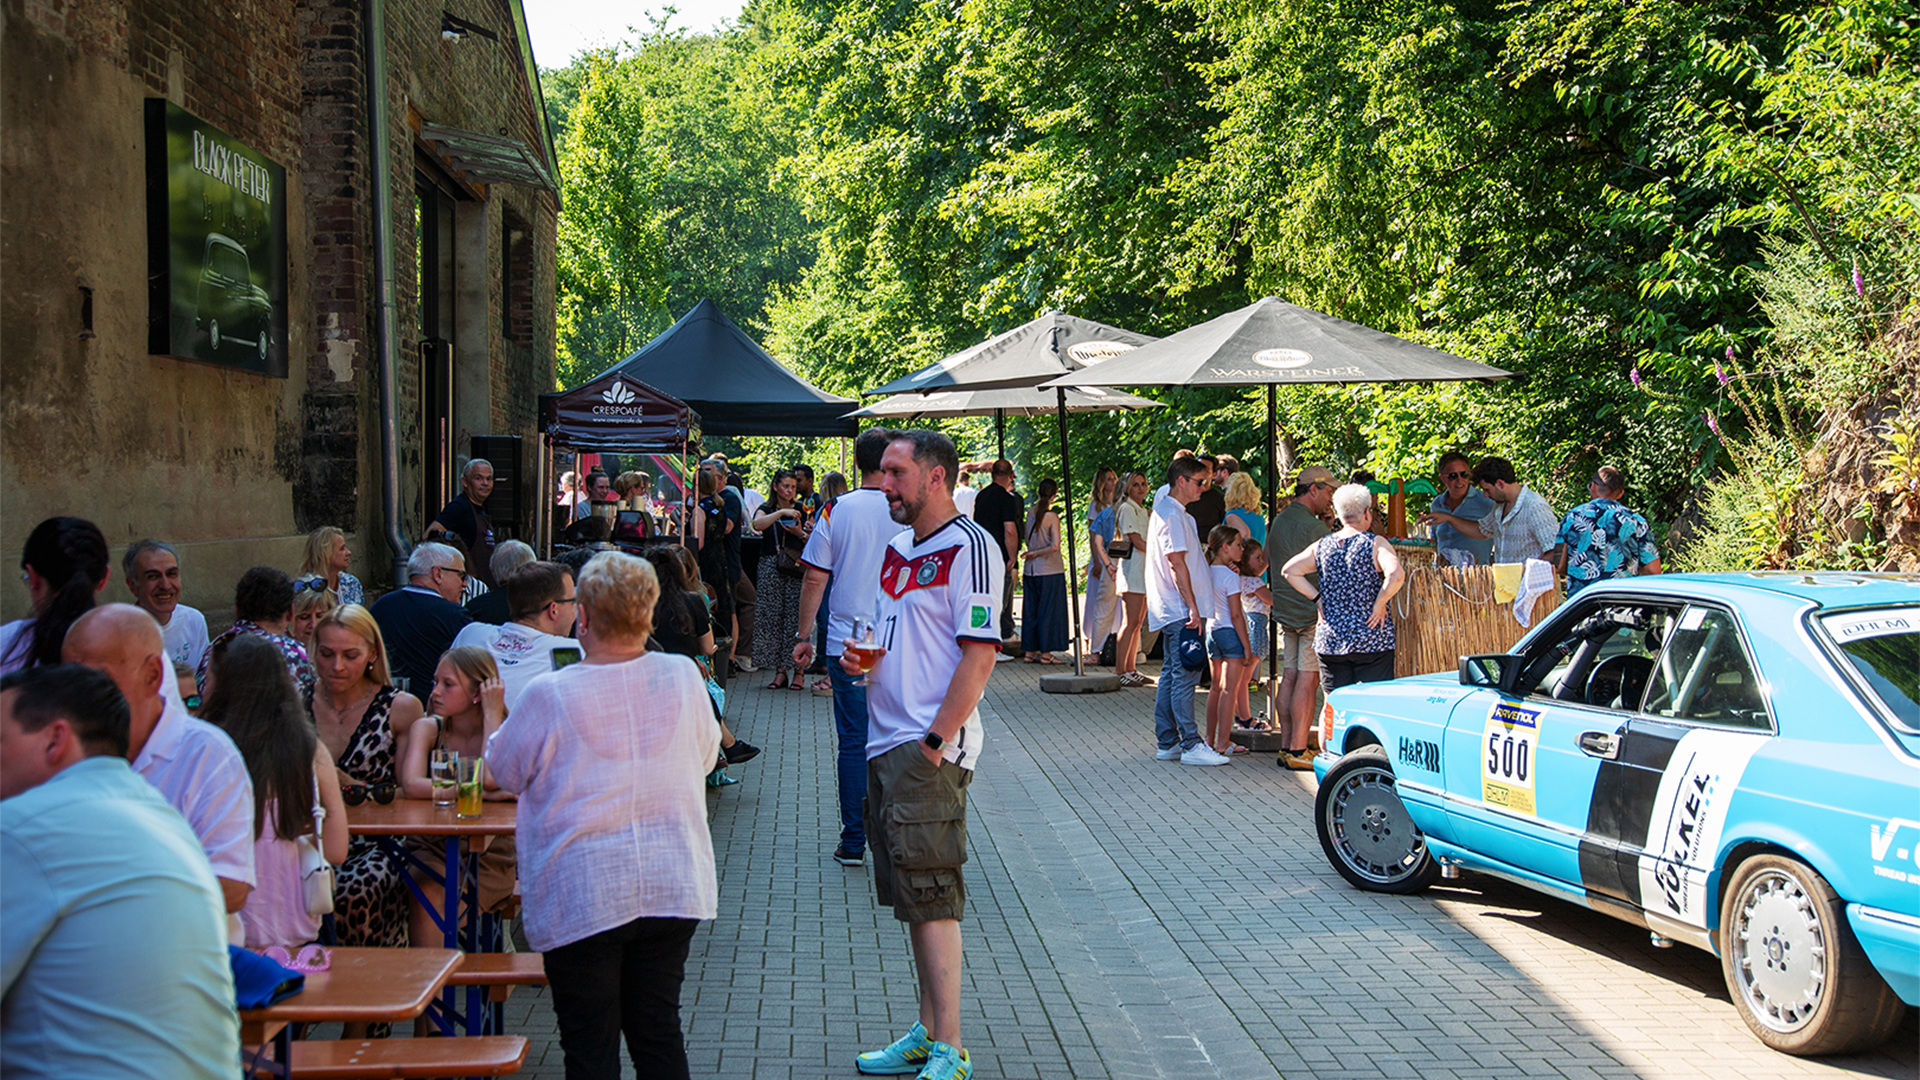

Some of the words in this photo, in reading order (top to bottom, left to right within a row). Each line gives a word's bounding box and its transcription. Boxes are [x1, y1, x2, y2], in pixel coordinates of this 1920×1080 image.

[193, 130, 232, 185] BLACK
[233, 152, 270, 205] PETER
[1210, 366, 1362, 378] WARSTEINER
[883, 616, 897, 650] 11
[1495, 707, 1534, 725] RAVENOL
[1399, 735, 1423, 765] H&R
[1488, 732, 1529, 782] 500
[1691, 810, 1706, 862] SOLUTIONS
[1873, 865, 1907, 882] THREAD
